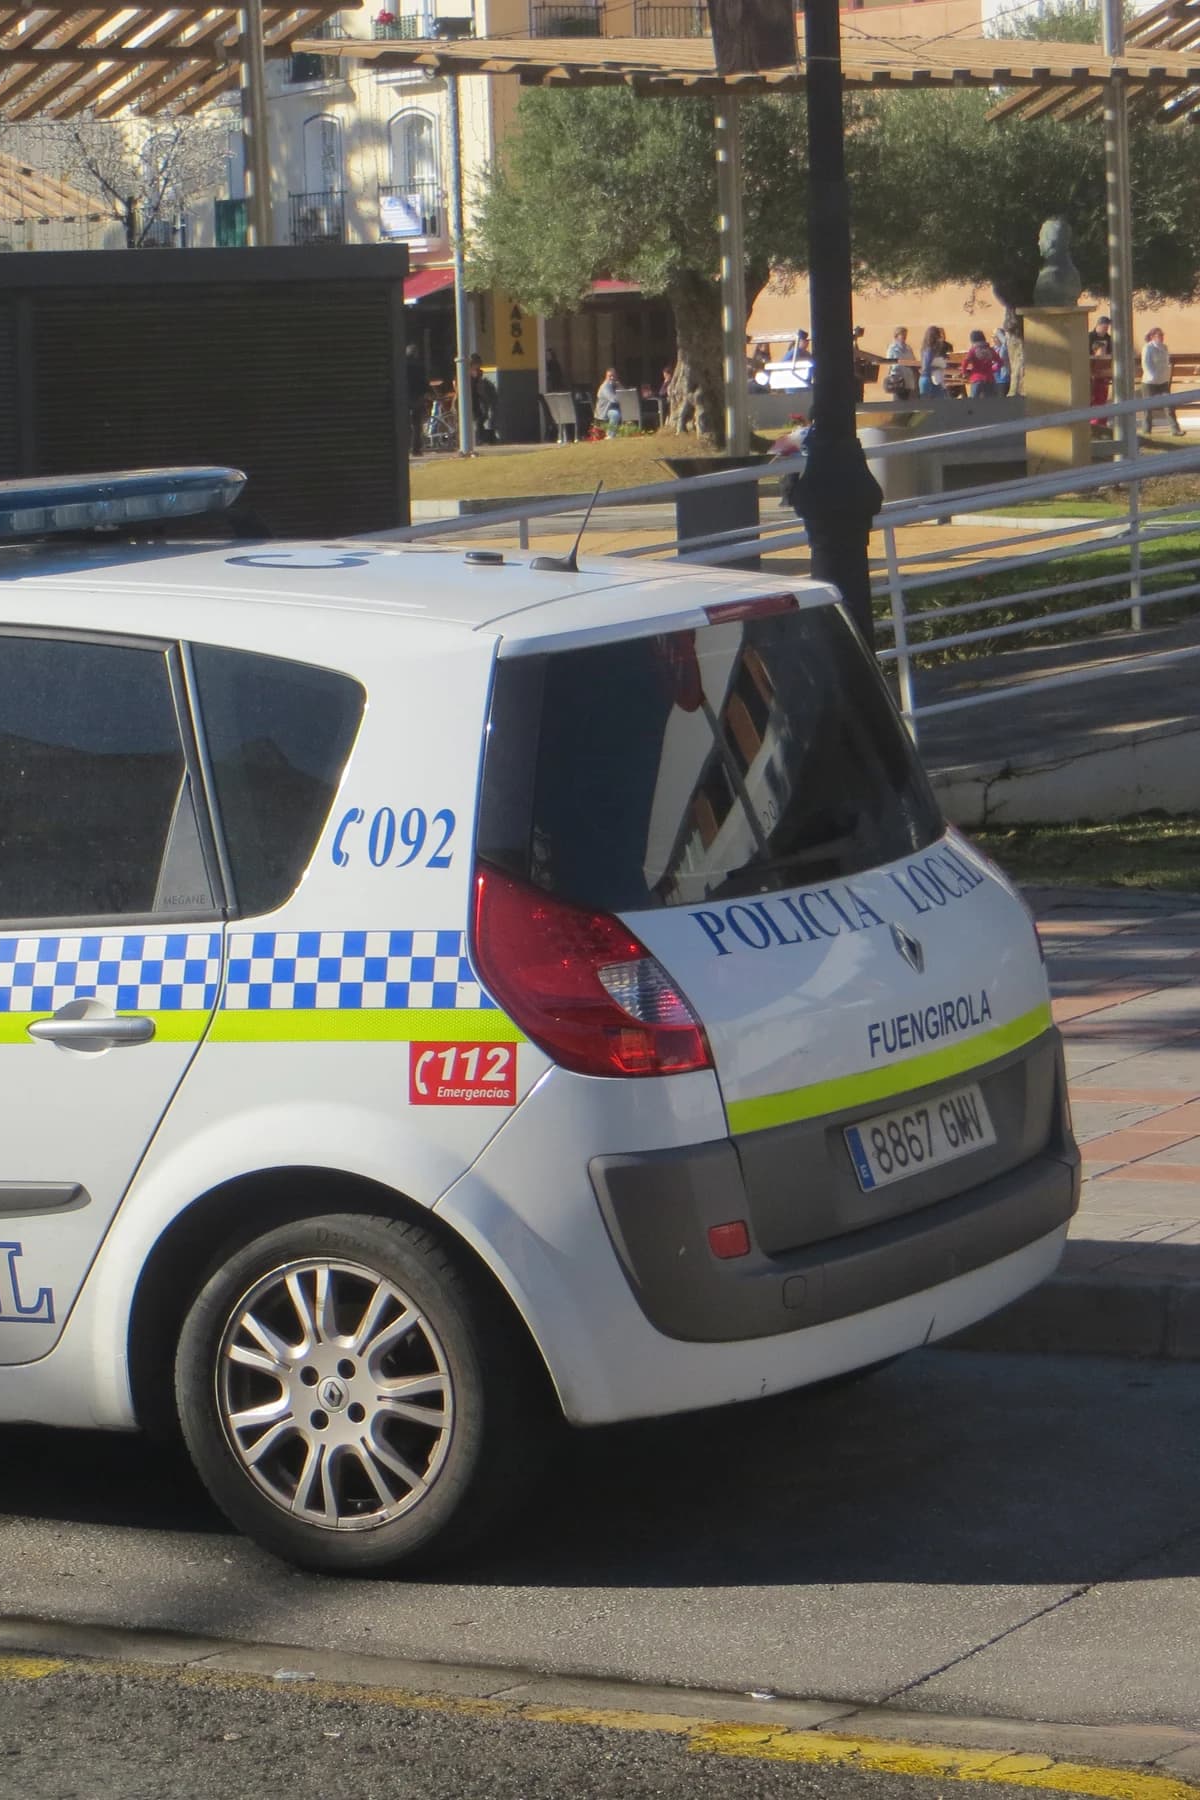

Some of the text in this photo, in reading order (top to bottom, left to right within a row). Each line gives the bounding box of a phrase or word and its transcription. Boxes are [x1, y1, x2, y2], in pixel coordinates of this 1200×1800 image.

[368, 806, 456, 869] 092
[688, 845, 985, 957] POLICIA LOCAL
[867, 989, 993, 1058] FUENGIROLA
[437, 1047, 510, 1081] 112
[437, 1086, 511, 1101] Emergencias
[871, 1109, 933, 1174] 8867
